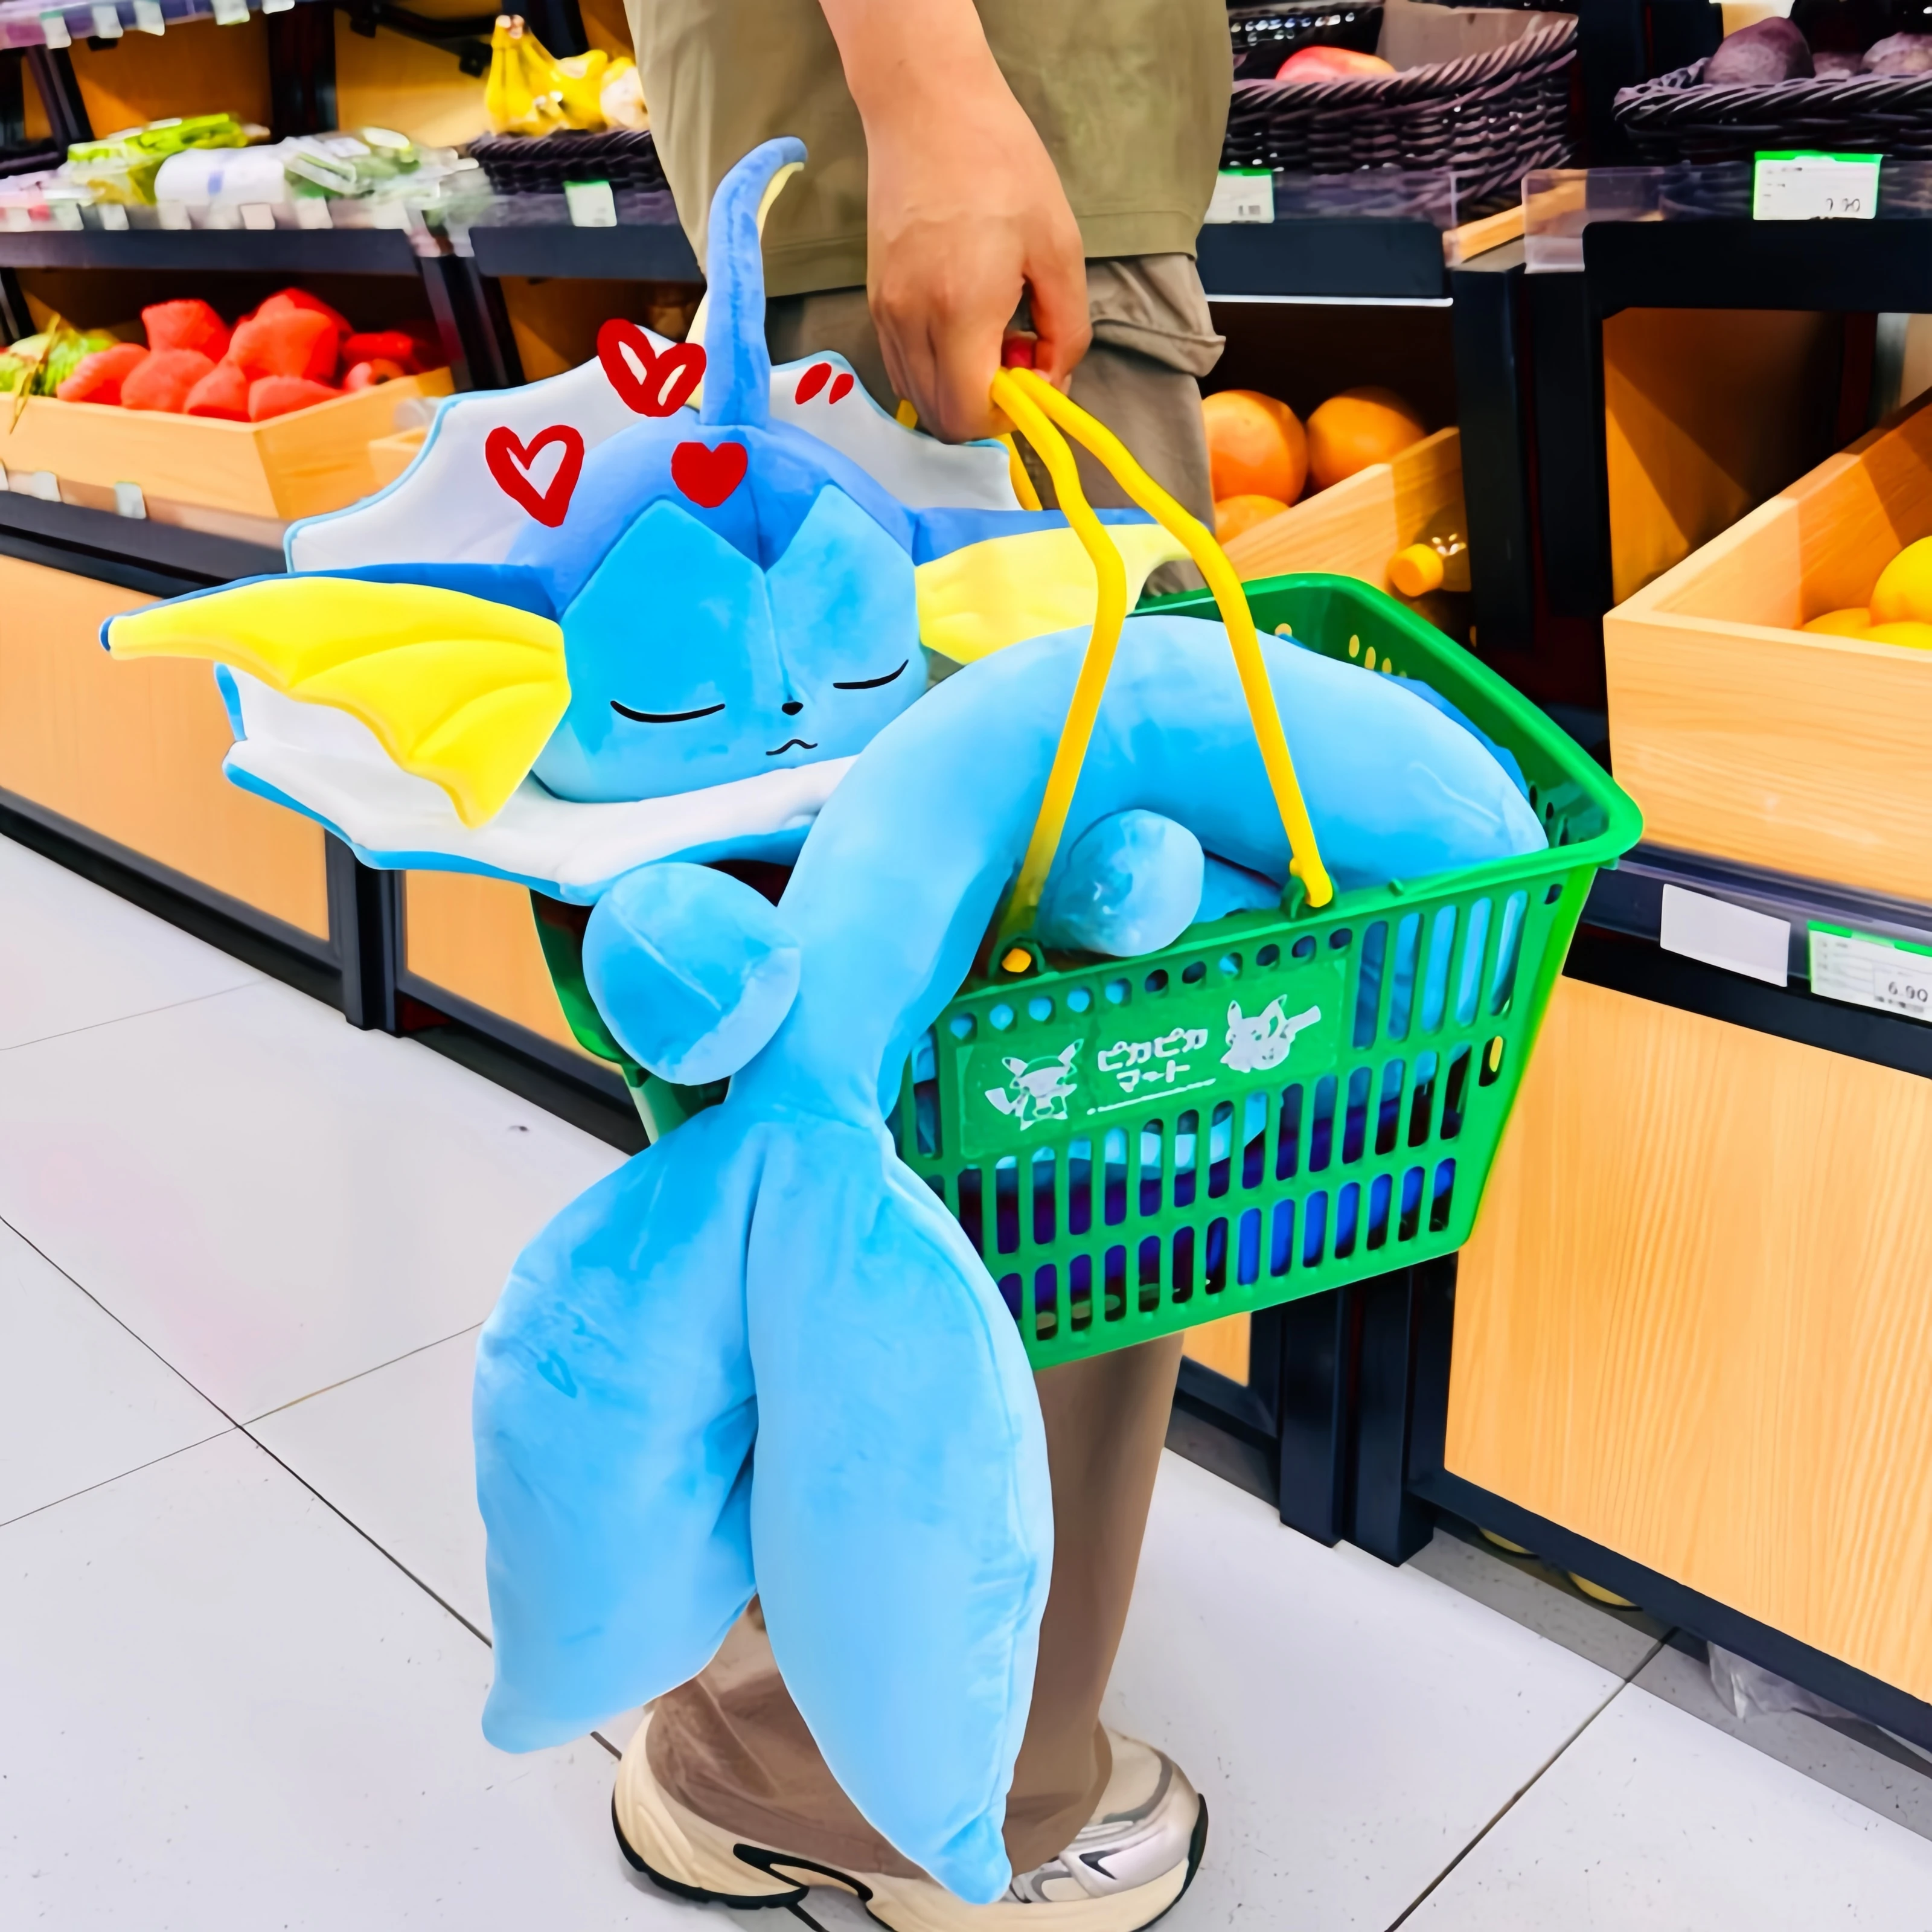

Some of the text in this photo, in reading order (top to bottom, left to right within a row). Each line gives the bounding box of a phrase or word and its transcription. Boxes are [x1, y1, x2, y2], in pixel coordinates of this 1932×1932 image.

[1098, 1028, 1208, 1072] ピカピカ
[1116, 1060, 1191, 1093] マート
